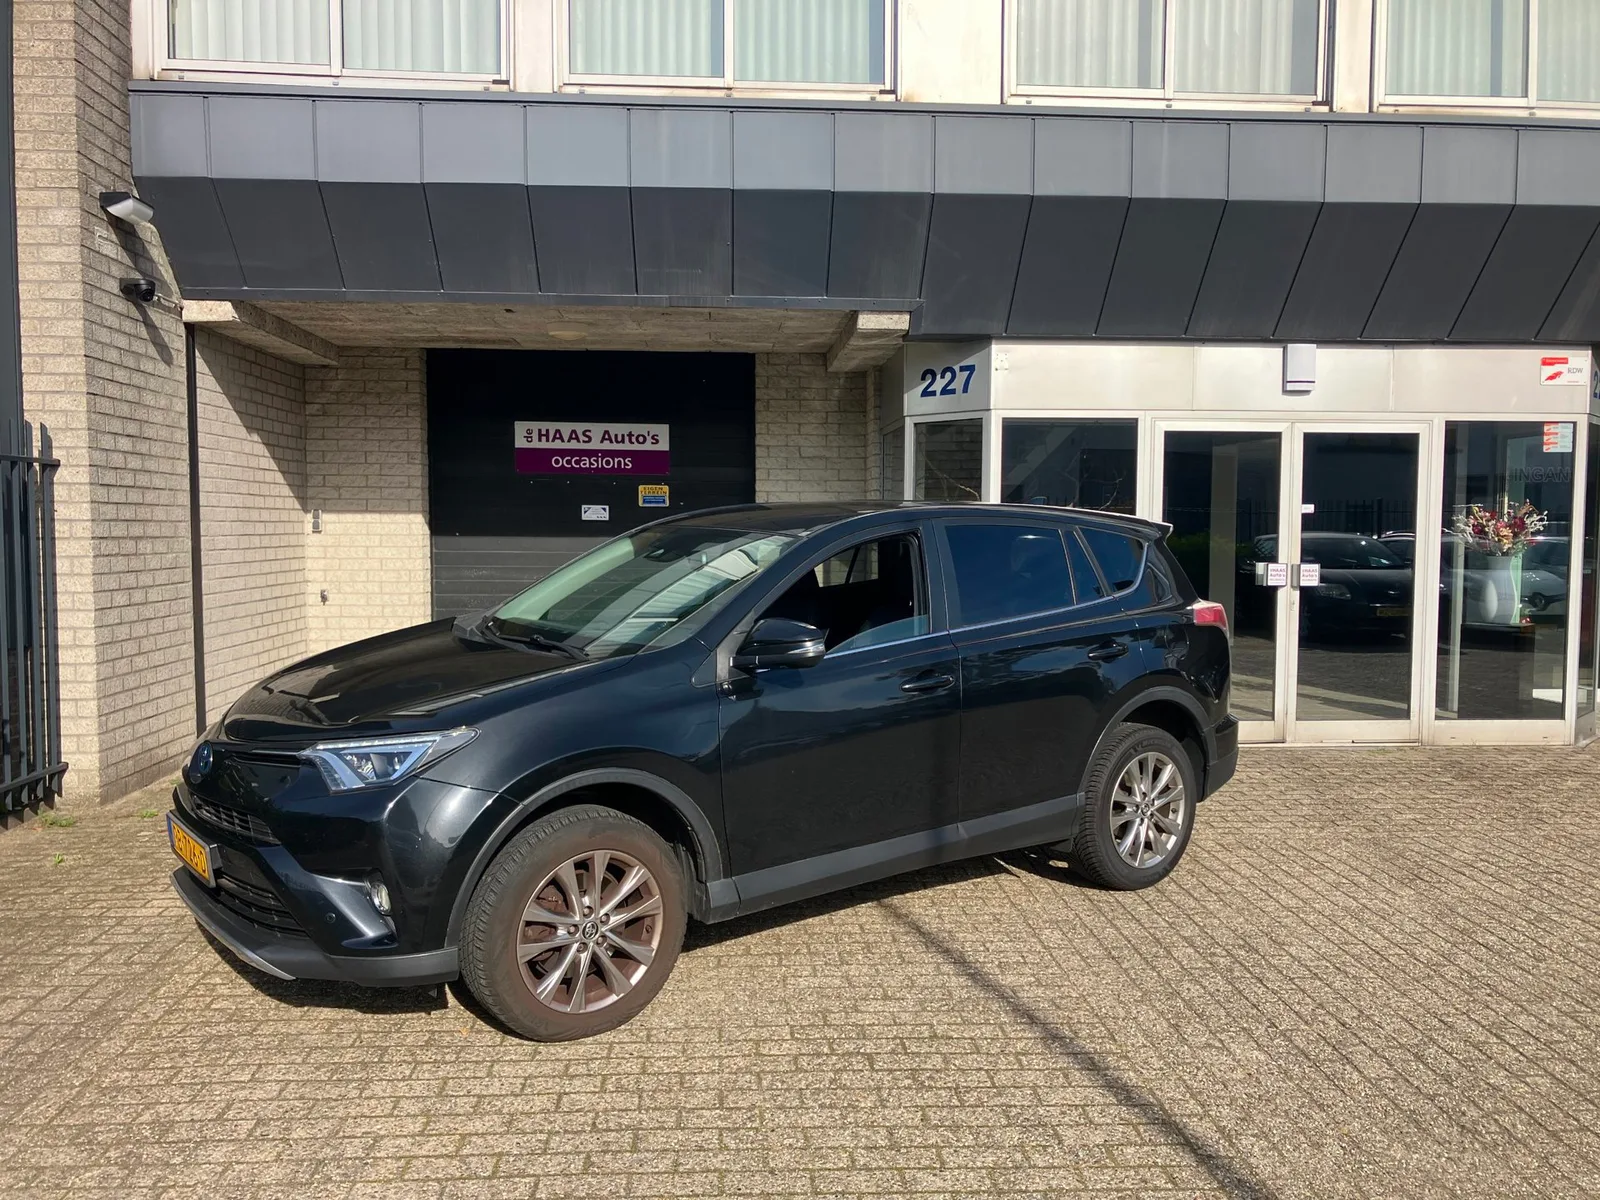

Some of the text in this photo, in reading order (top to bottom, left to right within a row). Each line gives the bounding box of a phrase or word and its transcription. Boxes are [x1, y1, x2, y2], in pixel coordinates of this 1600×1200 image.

[920, 364, 976, 398] 227
[523, 428, 660, 445] de HAAS Auto's
[551, 453, 633, 469] occasions
[1514, 466, 1571, 483] INGAN
